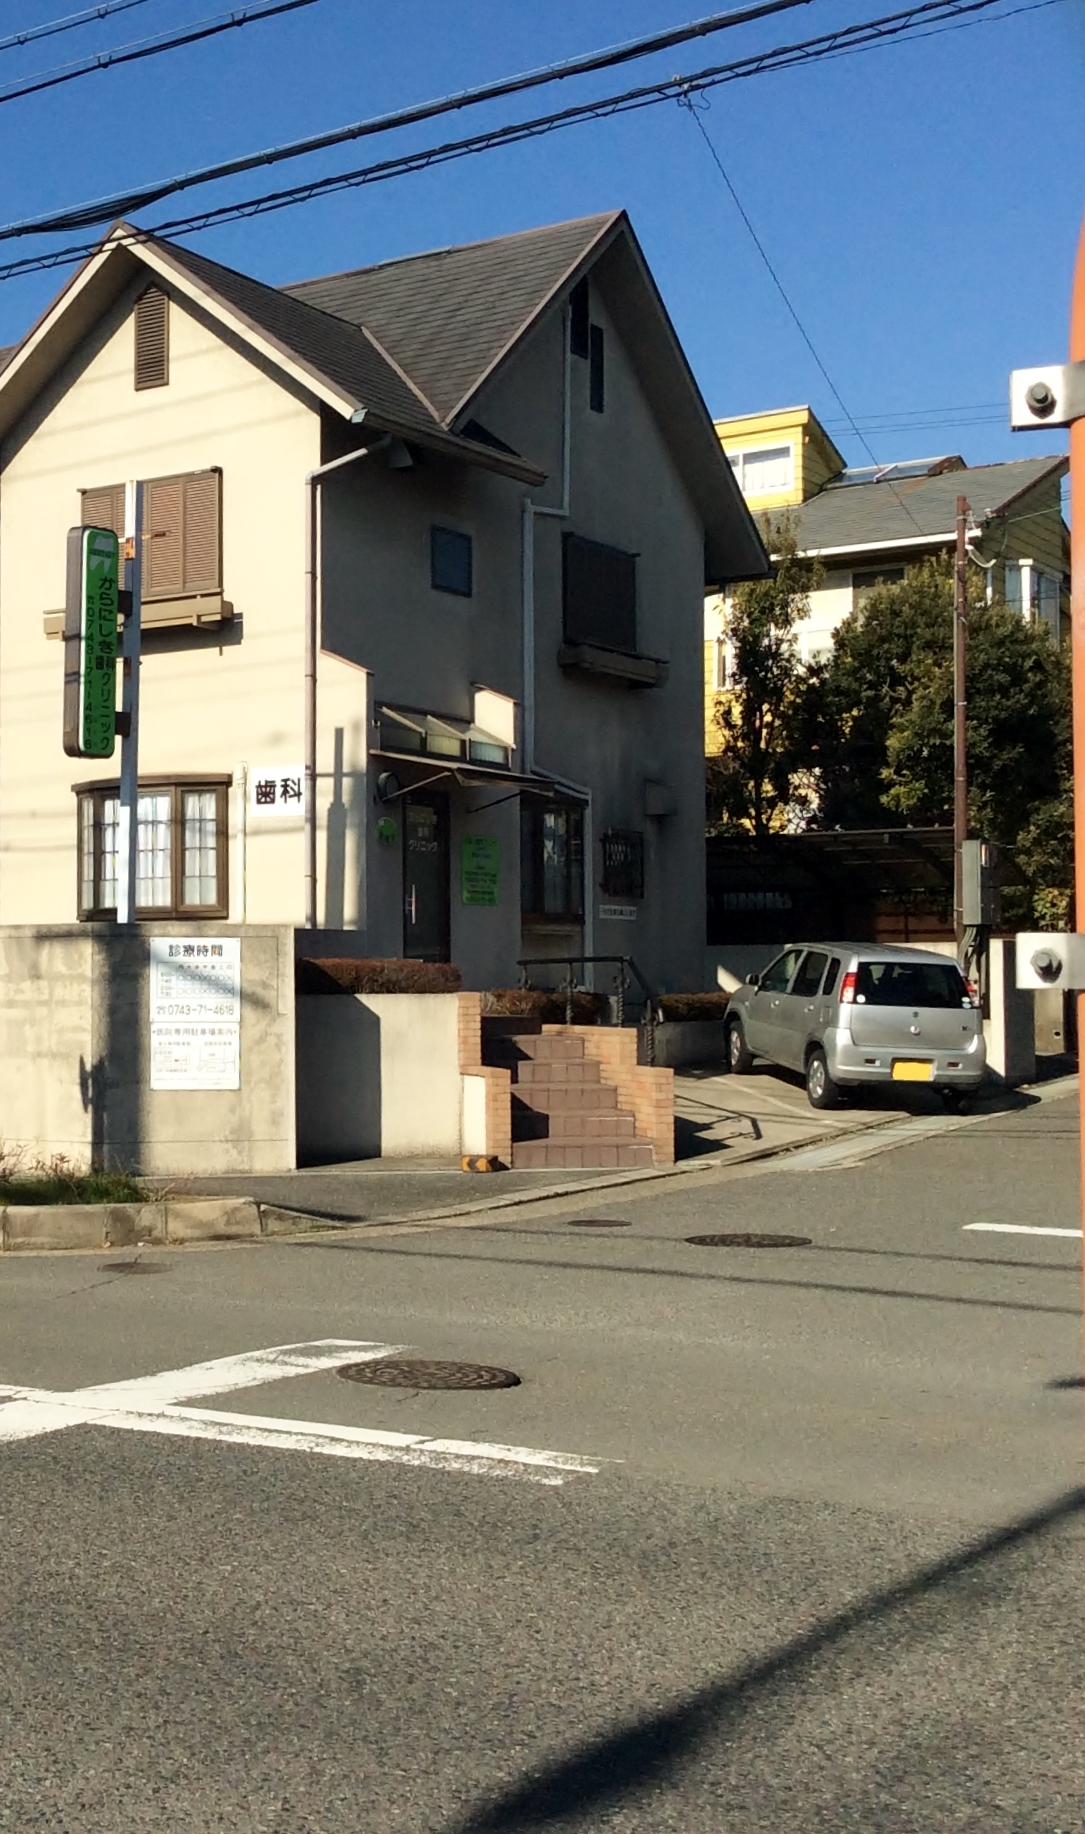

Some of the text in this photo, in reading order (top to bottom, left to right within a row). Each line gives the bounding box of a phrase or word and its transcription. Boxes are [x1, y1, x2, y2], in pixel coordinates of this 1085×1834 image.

[255, 777, 303, 805] 歯科
[168, 944, 223, 957] 診療時間
[167, 1004, 235, 1016] 0743-71-4618
